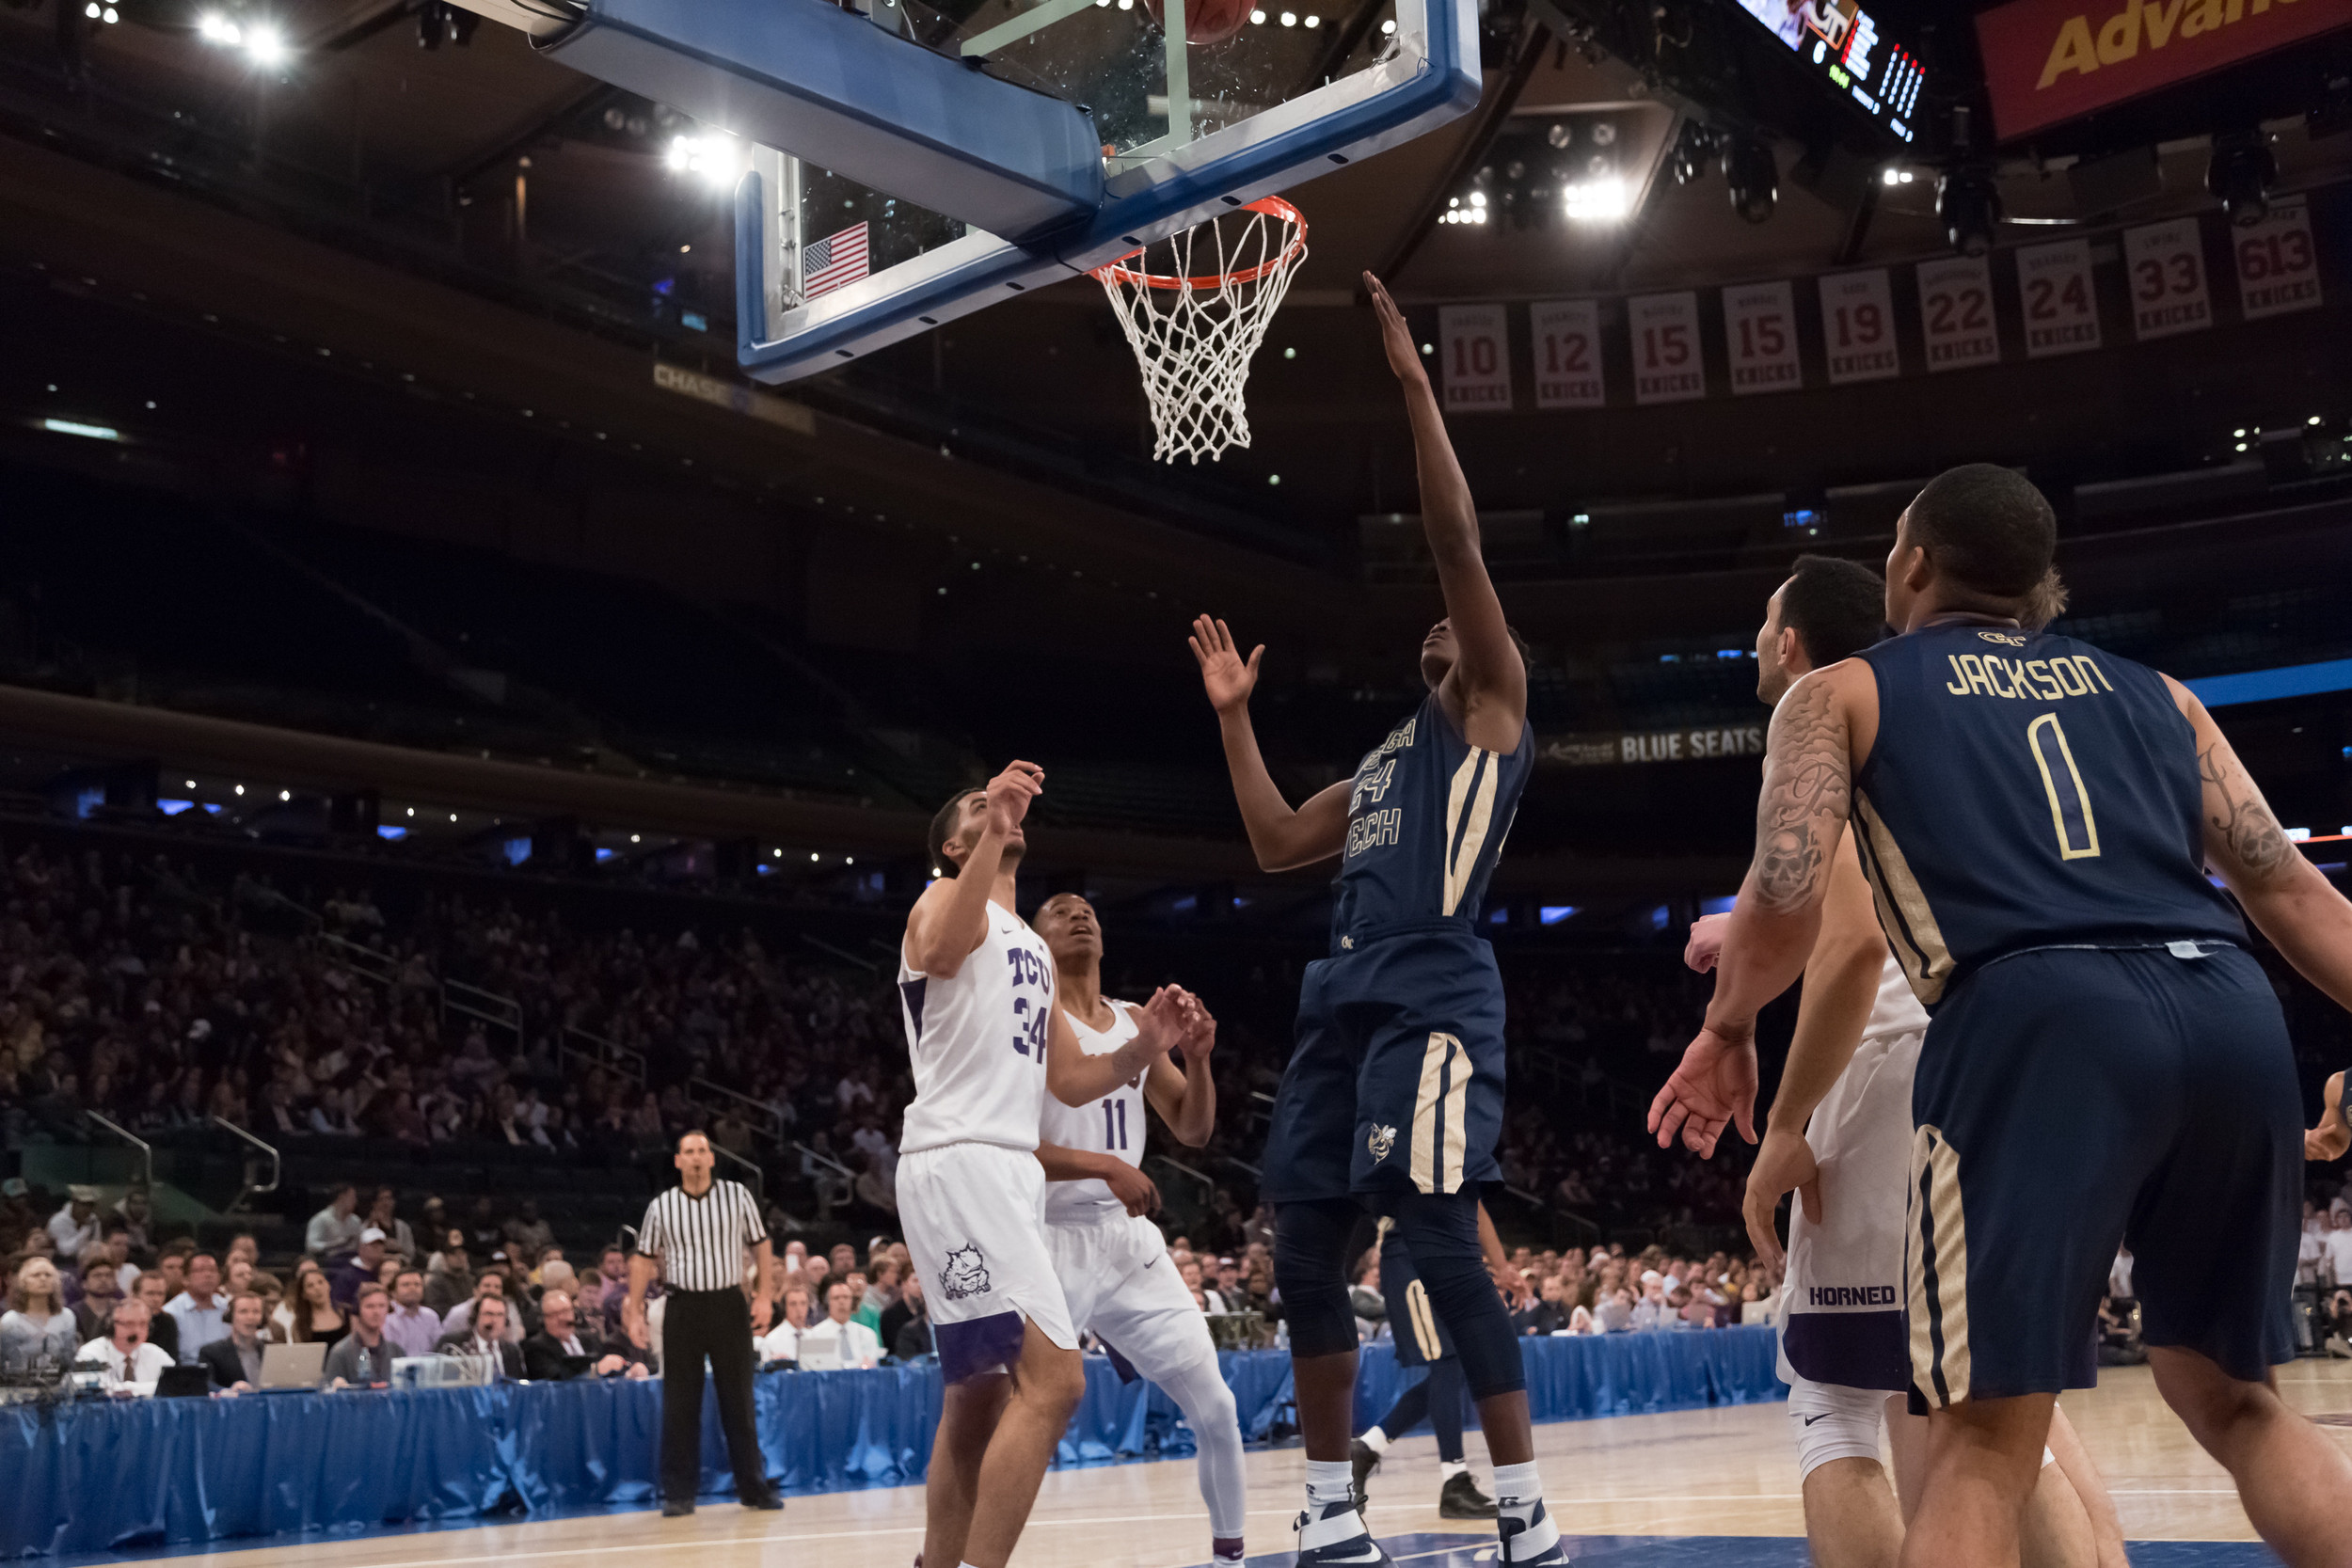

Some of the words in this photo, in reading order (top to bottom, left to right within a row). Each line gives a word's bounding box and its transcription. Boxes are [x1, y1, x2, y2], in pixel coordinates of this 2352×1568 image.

[2035, 0, 2298, 90] Adva
[2137, 252, 2200, 302] 33
[2239, 230, 2312, 282] 613
[1928, 288, 1989, 335] 22
[2027, 274, 2090, 321] 24
[2247, 278, 2317, 309] KNICKS
[1739, 315, 1786, 357] 15
[1836, 303, 1883, 347] 19
[2029, 323, 2097, 349] KNICKS
[2138, 300, 2207, 332] KNICKS
[1454, 336, 1497, 377] 10
[1544, 332, 1590, 373] 12
[1644, 325, 1690, 369] 15
[1832, 350, 1895, 376] KNICKS
[1931, 336, 1995, 362] KNICKS
[1447, 384, 1508, 403] KNICKS
[1540, 380, 1599, 400] KNICKS
[1639, 372, 1701, 395] KNICKS
[1735, 362, 1797, 386] KNICKS
[1947, 654, 2114, 701] JACKSON
[1621, 733, 1684, 764] BLUE
[1690, 726, 1764, 758] SEATS
[2027, 712, 2101, 861] 1
[1343, 808, 1402, 863] ECH
[1008, 947, 1051, 995] TCU
[1013, 997, 1047, 1065] 34
[1102, 1099, 1128, 1149] 11
[1809, 1285, 1896, 1306] HORNED
